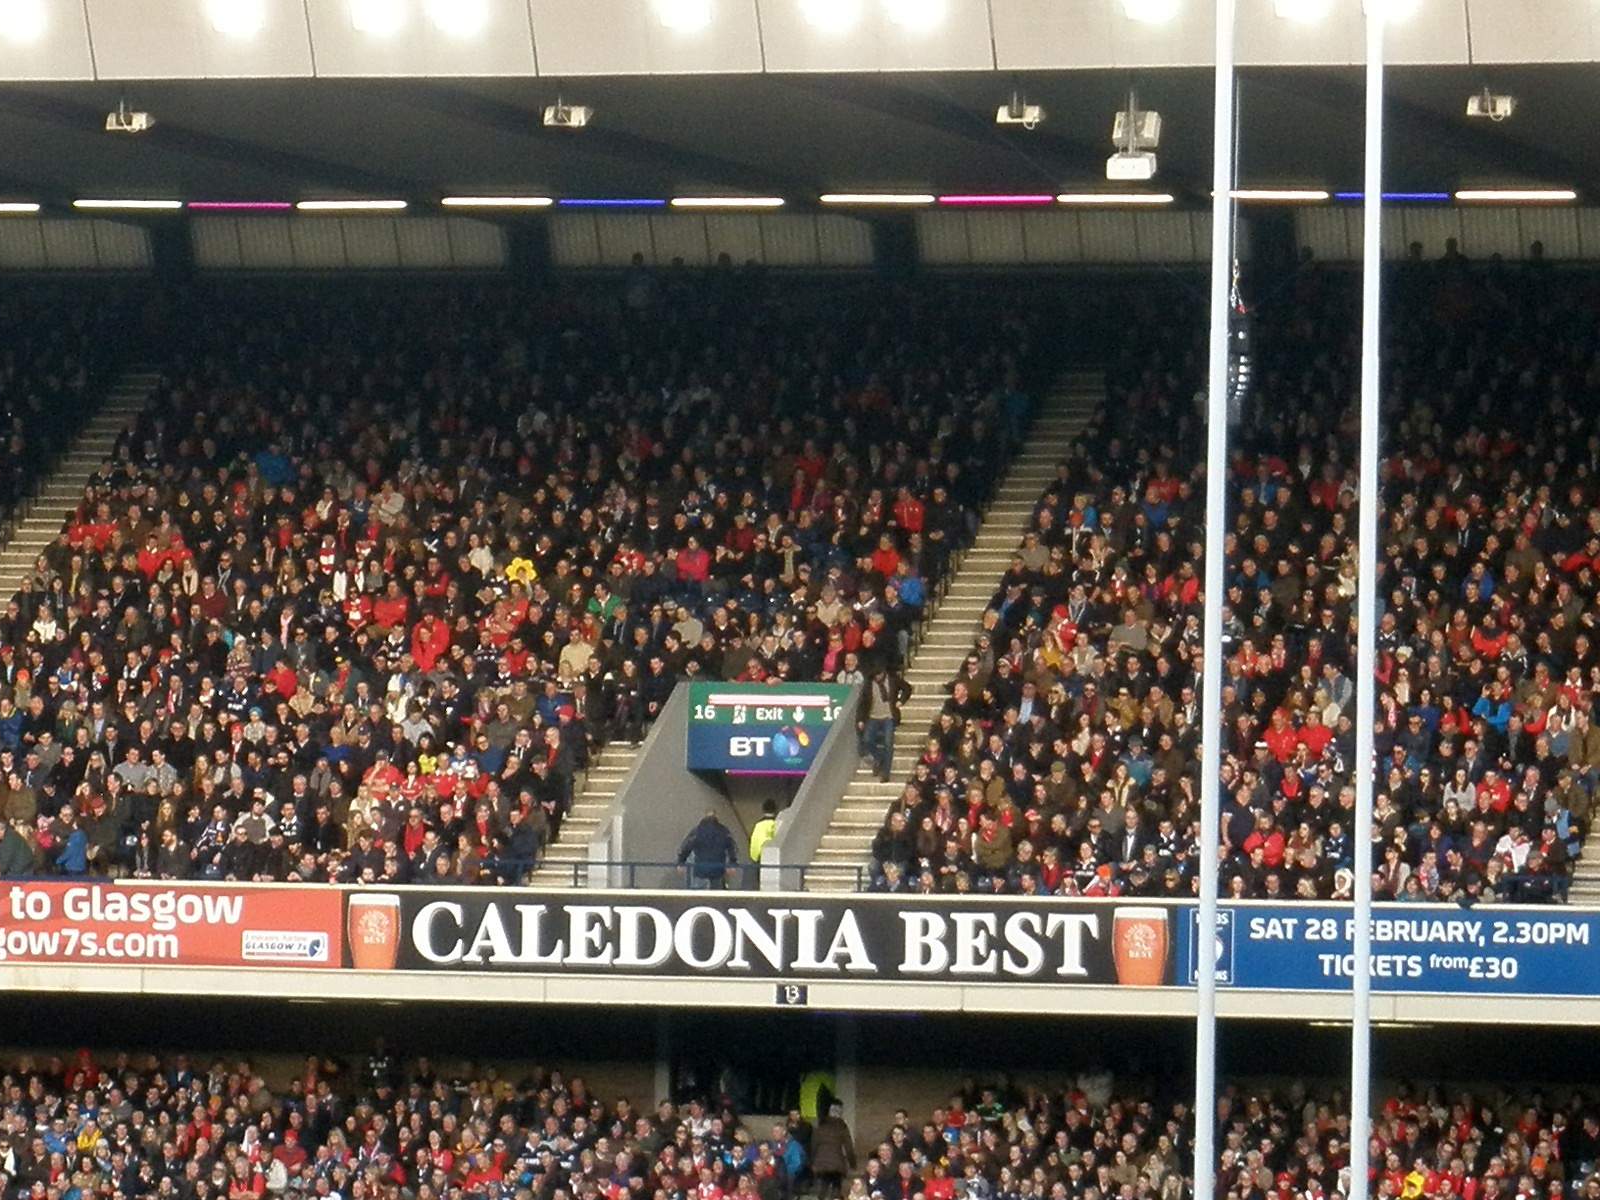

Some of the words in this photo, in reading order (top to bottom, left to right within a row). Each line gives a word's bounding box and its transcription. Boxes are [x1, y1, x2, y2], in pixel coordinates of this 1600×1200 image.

[694, 705, 716, 720] 16
[756, 707, 783, 721] Exit
[729, 737, 771, 757] BT
[10, 886, 51, 920] to
[63, 886, 243, 931] Glasgow
[411, 902, 877, 972] CALEDONIA
[898, 910, 1098, 976] BEST
[1249, 918, 1298, 940] SAT
[1304, 918, 1338, 940] 28
[1492, 922, 1590, 945] 2.30PM
[1318, 954, 1422, 977] TICETS
[1429, 953, 1469, 970] from
[1468, 958, 1518, 979] £30
[784, 985, 800, 1004] 13
